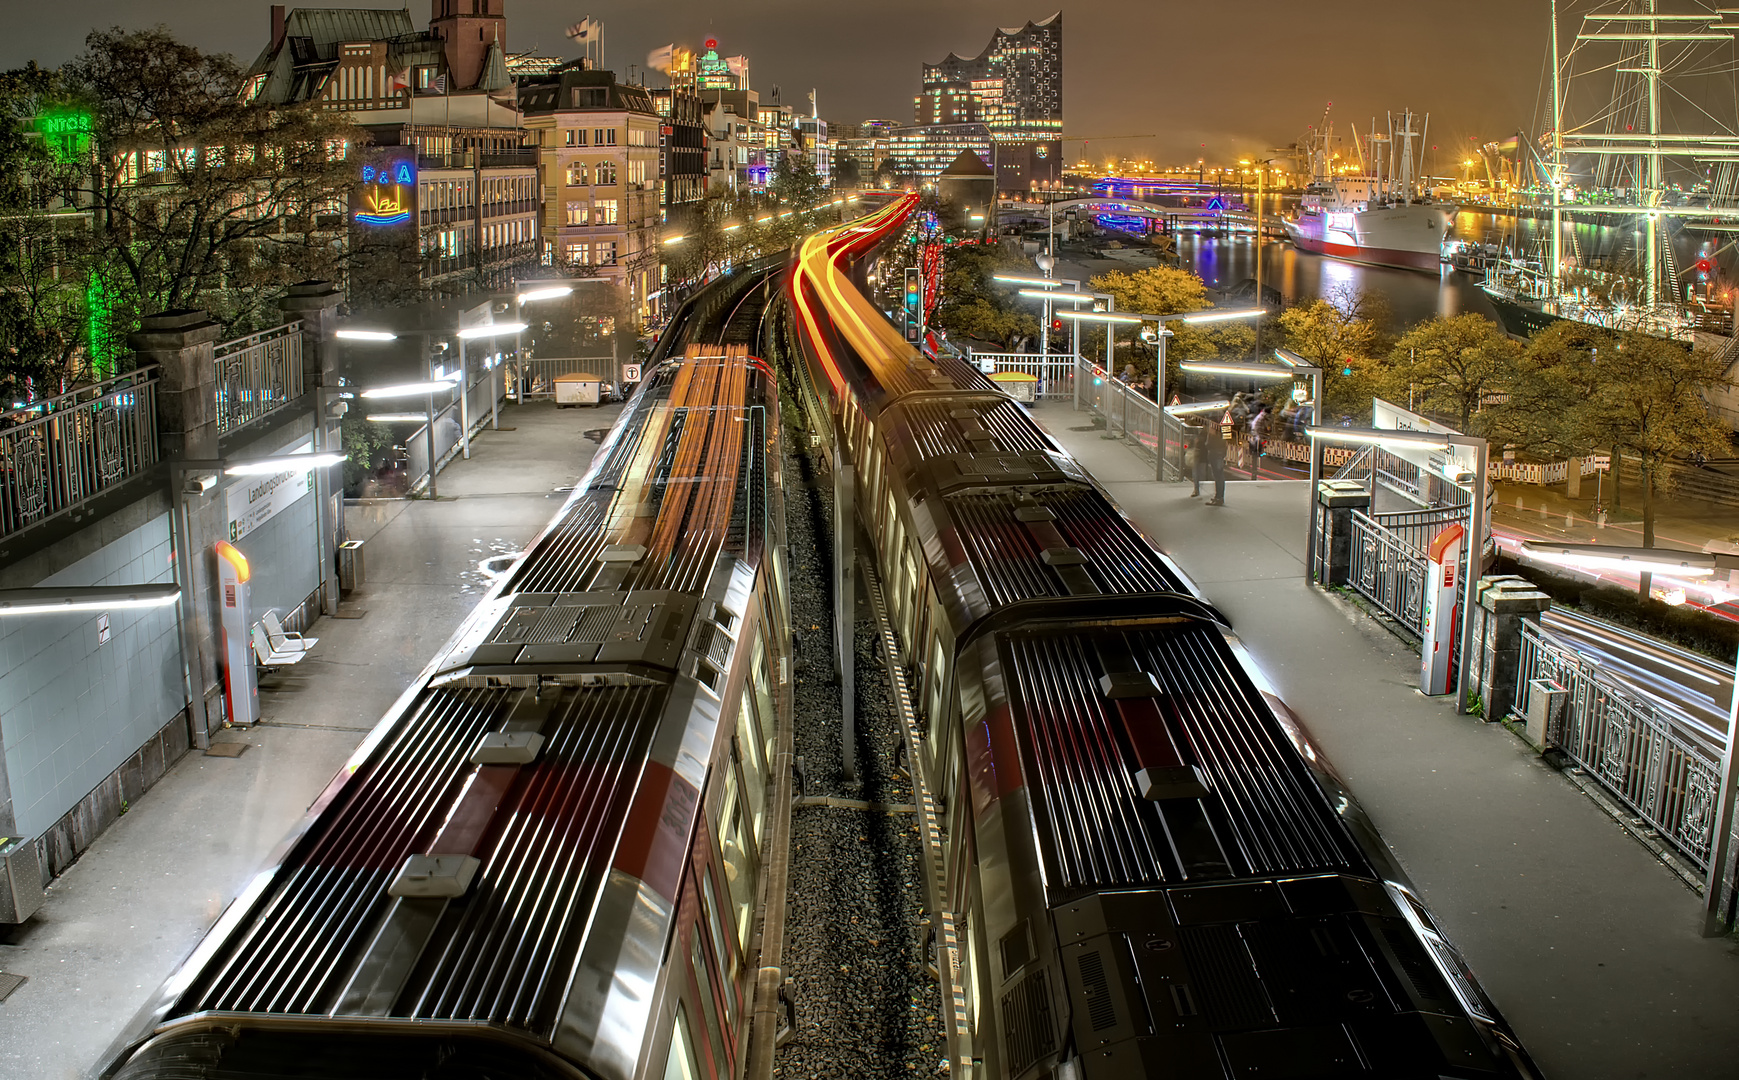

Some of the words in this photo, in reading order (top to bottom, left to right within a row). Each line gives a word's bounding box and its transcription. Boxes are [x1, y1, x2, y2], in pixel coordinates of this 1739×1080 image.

[363, 166, 375, 184] P
[379, 171, 389, 184] &
[397, 165, 411, 183] A
